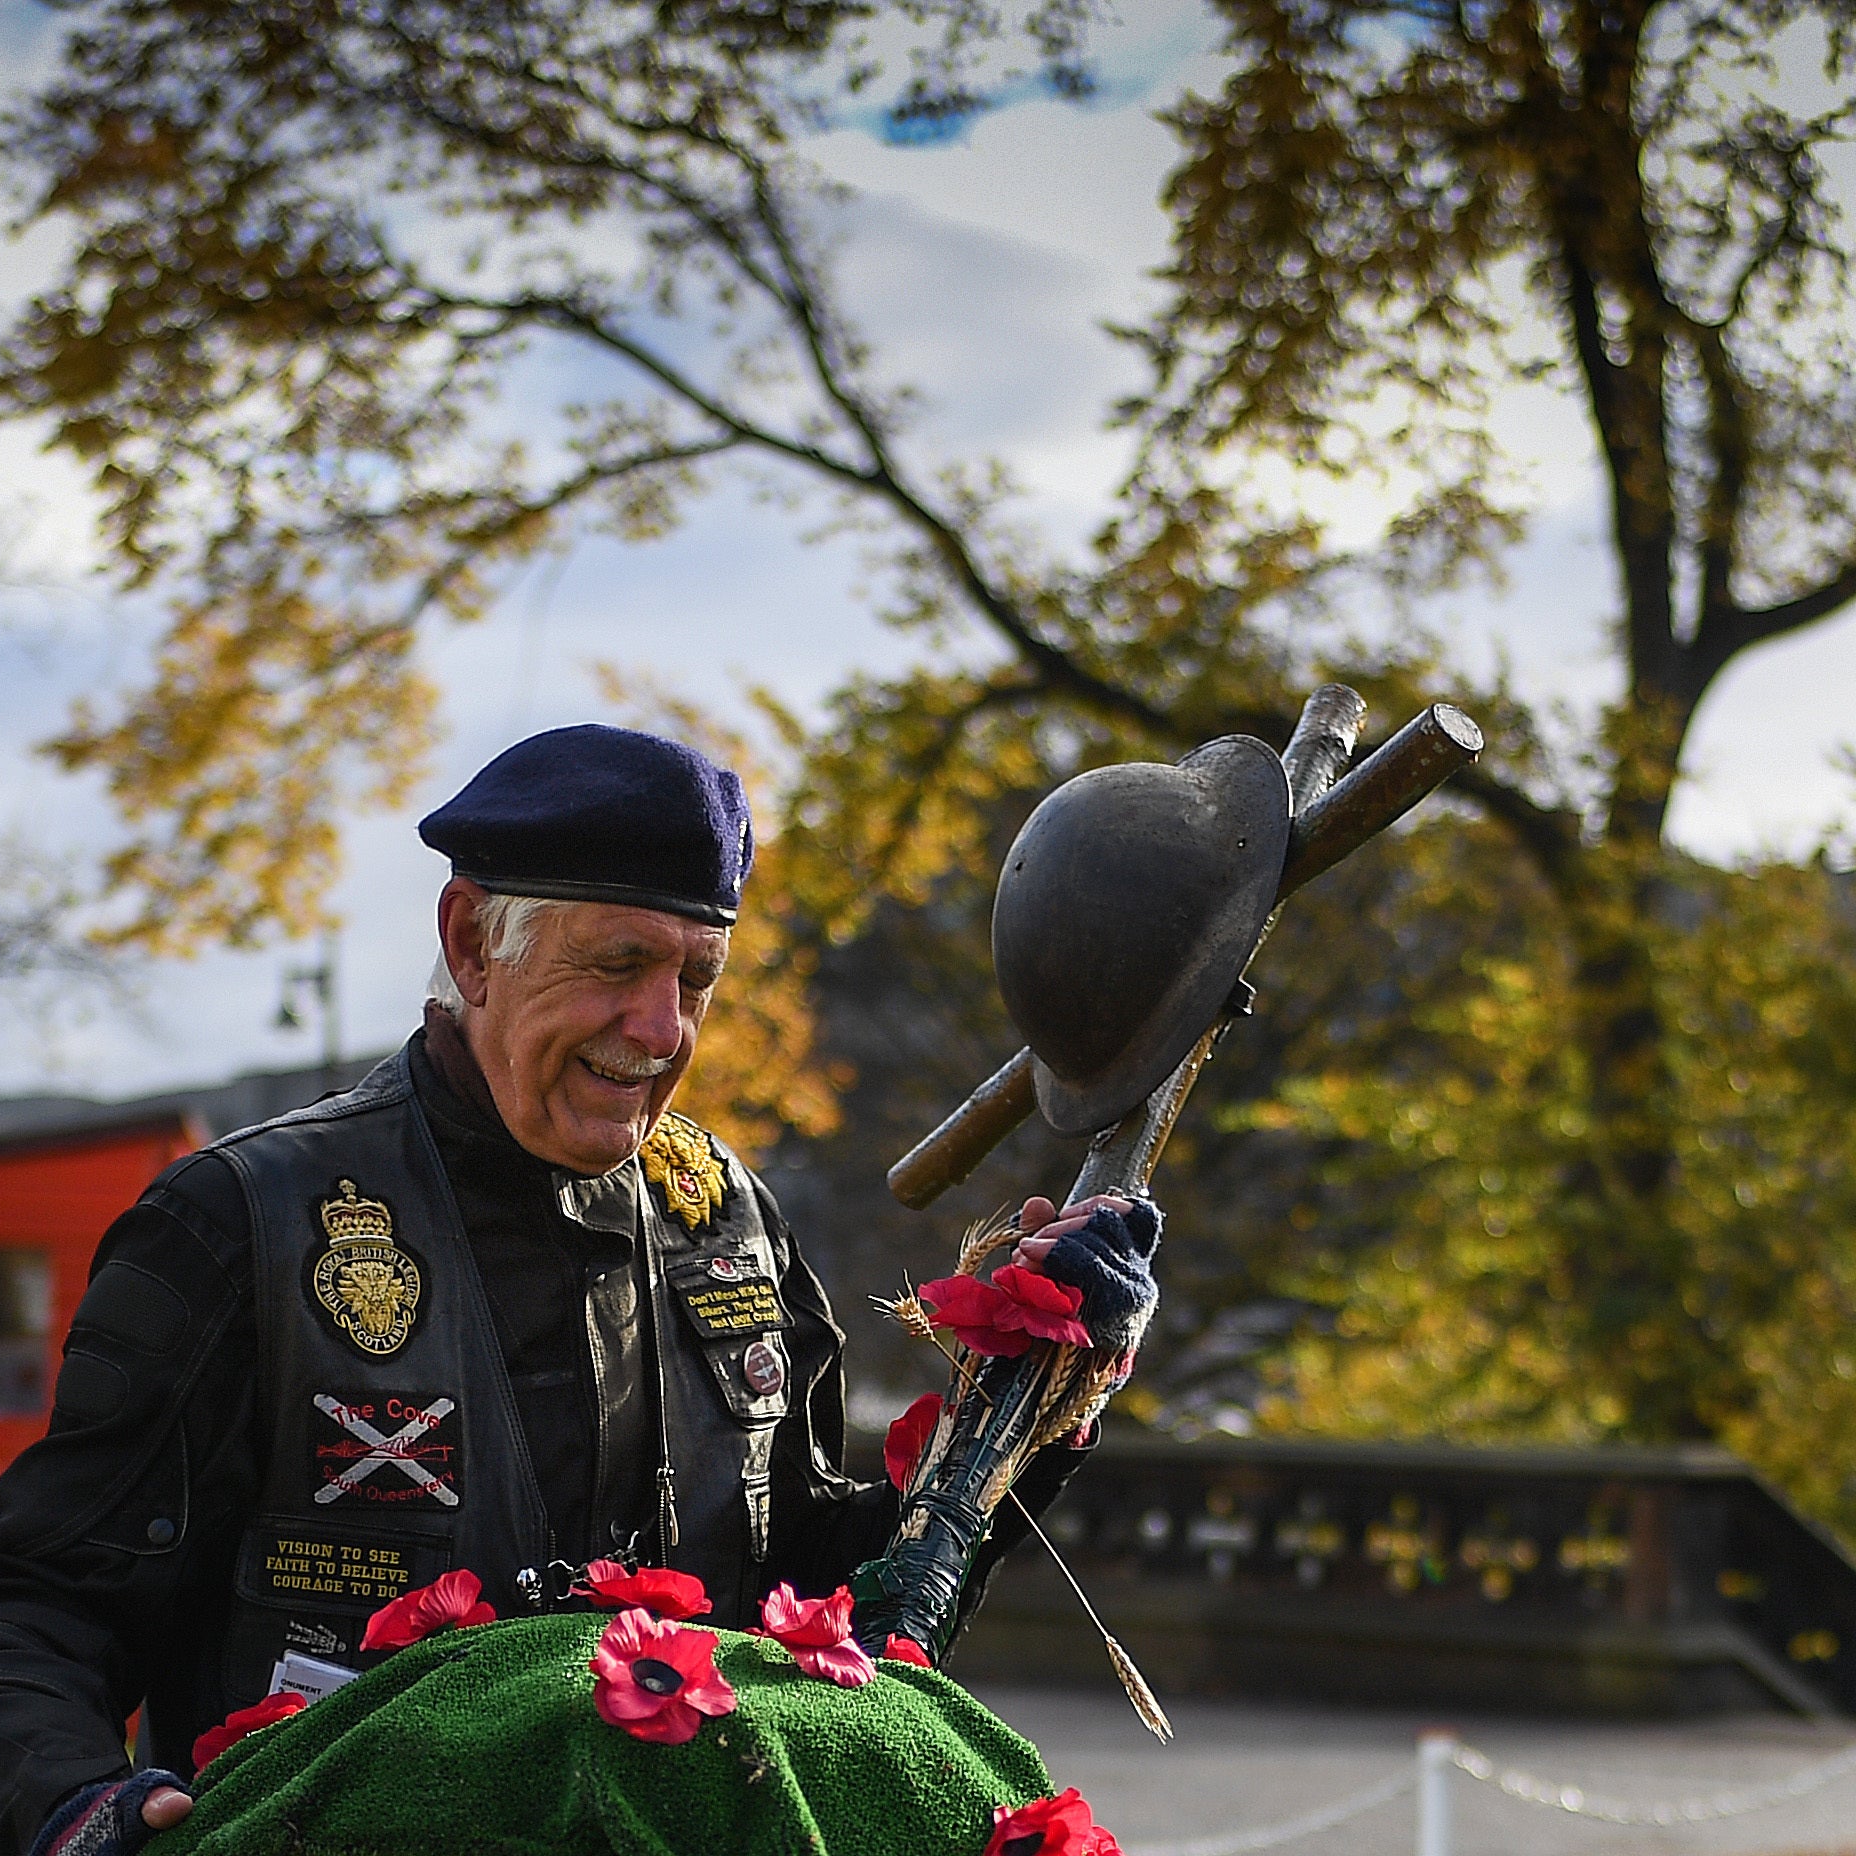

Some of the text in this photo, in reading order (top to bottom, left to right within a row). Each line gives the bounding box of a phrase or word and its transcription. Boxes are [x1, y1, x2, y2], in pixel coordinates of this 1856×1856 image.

[318, 1246, 416, 1310] THE ROYAL BRITISH LEGION
[687, 1292, 715, 1307] Don't
[713, 1290, 740, 1302] Mess
[737, 1285, 759, 1298] With
[731, 1301, 754, 1313] They
[708, 1309, 781, 1329] Just LOOK Crazy!
[351, 1319, 405, 1351] SCOTLAND
[332, 1398, 442, 1431] The Cove
[323, 1464, 455, 1501] South Queensferry
[277, 1540, 401, 1565] VISION TO SEE
[265, 1556, 409, 1583] FAITH TO BELIEVE
[273, 1574, 399, 1598] COURAGE TO DO
